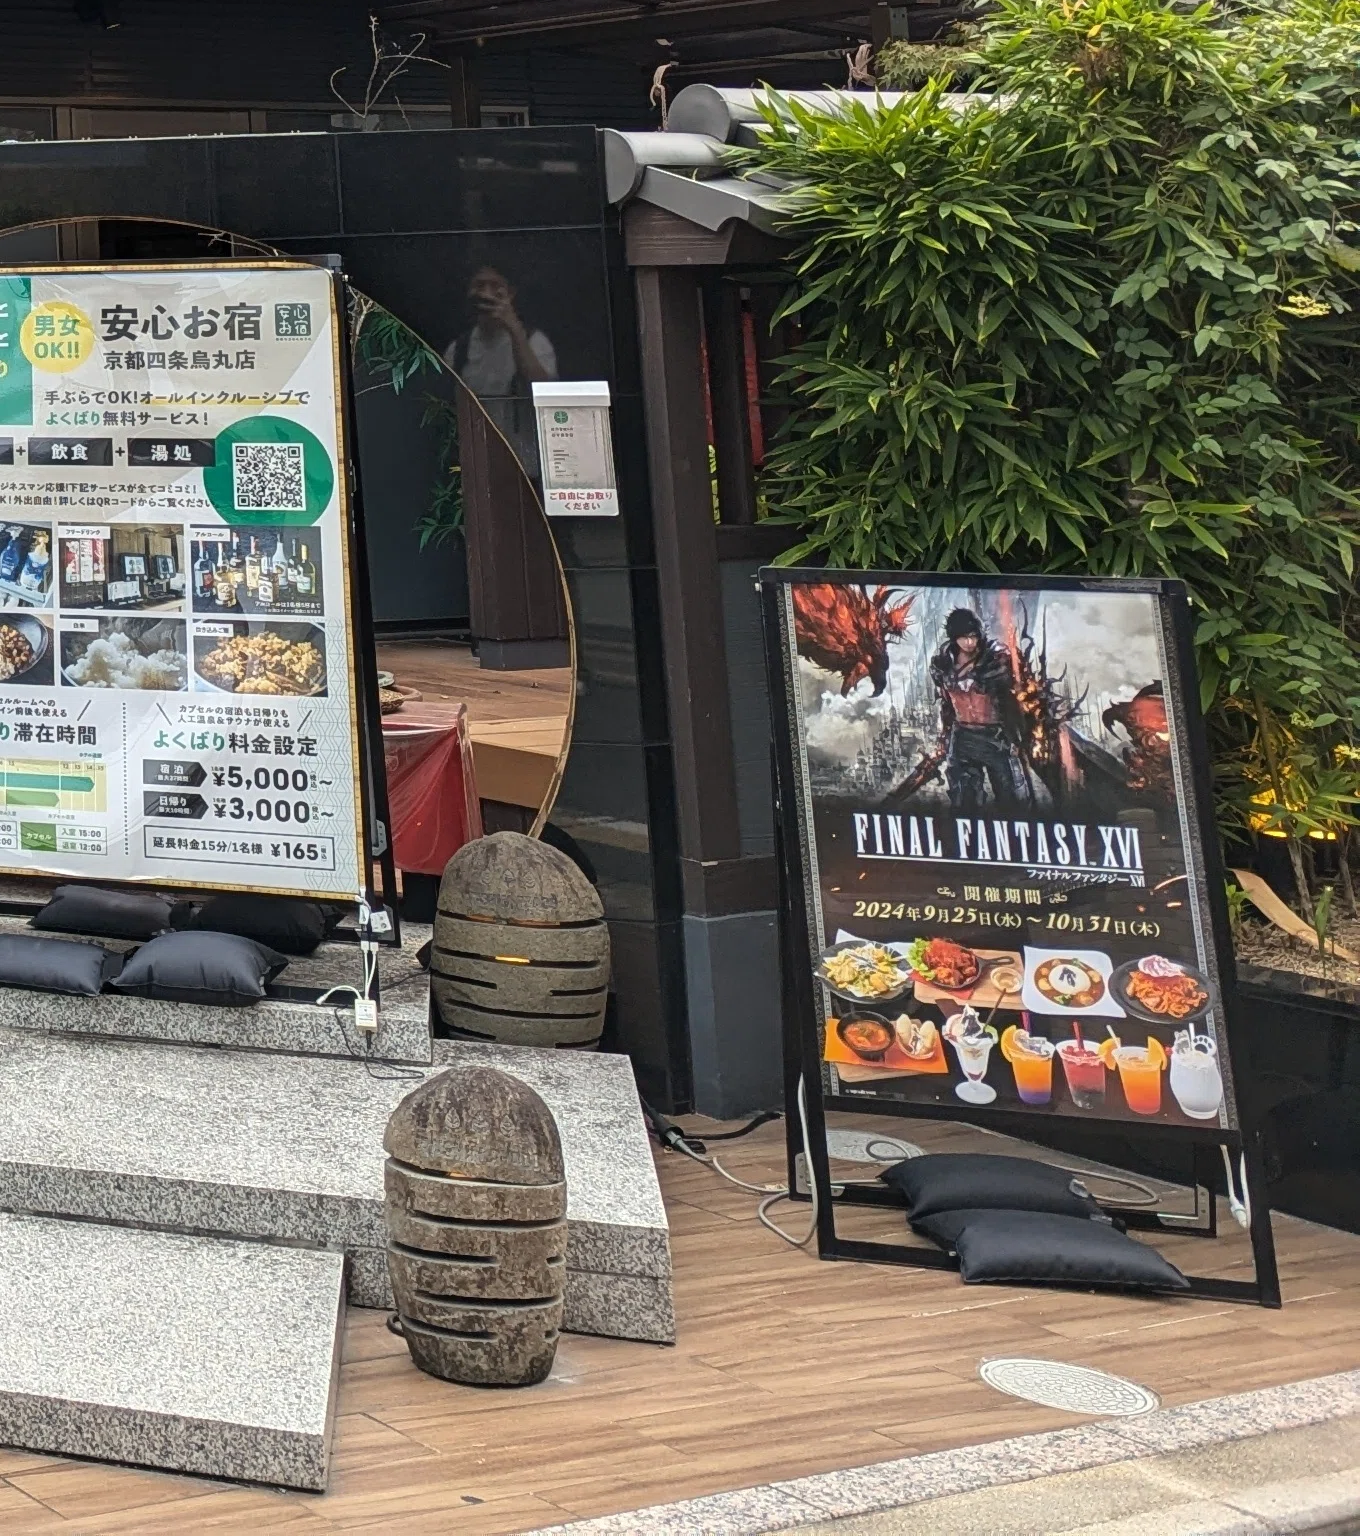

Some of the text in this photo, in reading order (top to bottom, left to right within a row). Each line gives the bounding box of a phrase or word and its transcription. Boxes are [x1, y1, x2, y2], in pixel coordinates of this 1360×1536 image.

[35, 316, 80, 337] 男女
[100, 302, 262, 342] 安心お宿
[34, 342, 80, 359] OK!!
[103, 350, 255, 370] 京都四条烏丸店
[51, 444, 88, 460] 飲食
[151, 444, 192, 462] 湯処
[550, 492, 612, 500] ご自由にお取り
[565, 502, 600, 511] ください
[154, 731, 318, 756] よくばり料金設定
[160, 764, 184, 773] 宿泊
[213, 766, 308, 791] ¥5,000
[159, 796, 187, 807] 日帰り
[214, 797, 310, 823] ¥3,000
[153, 837, 318, 861] 延長料金15分/1名様 ¥165
[853, 813, 1144, 870] FINAL FANTASY XVI
[964, 886, 1042, 906] 開催期間
